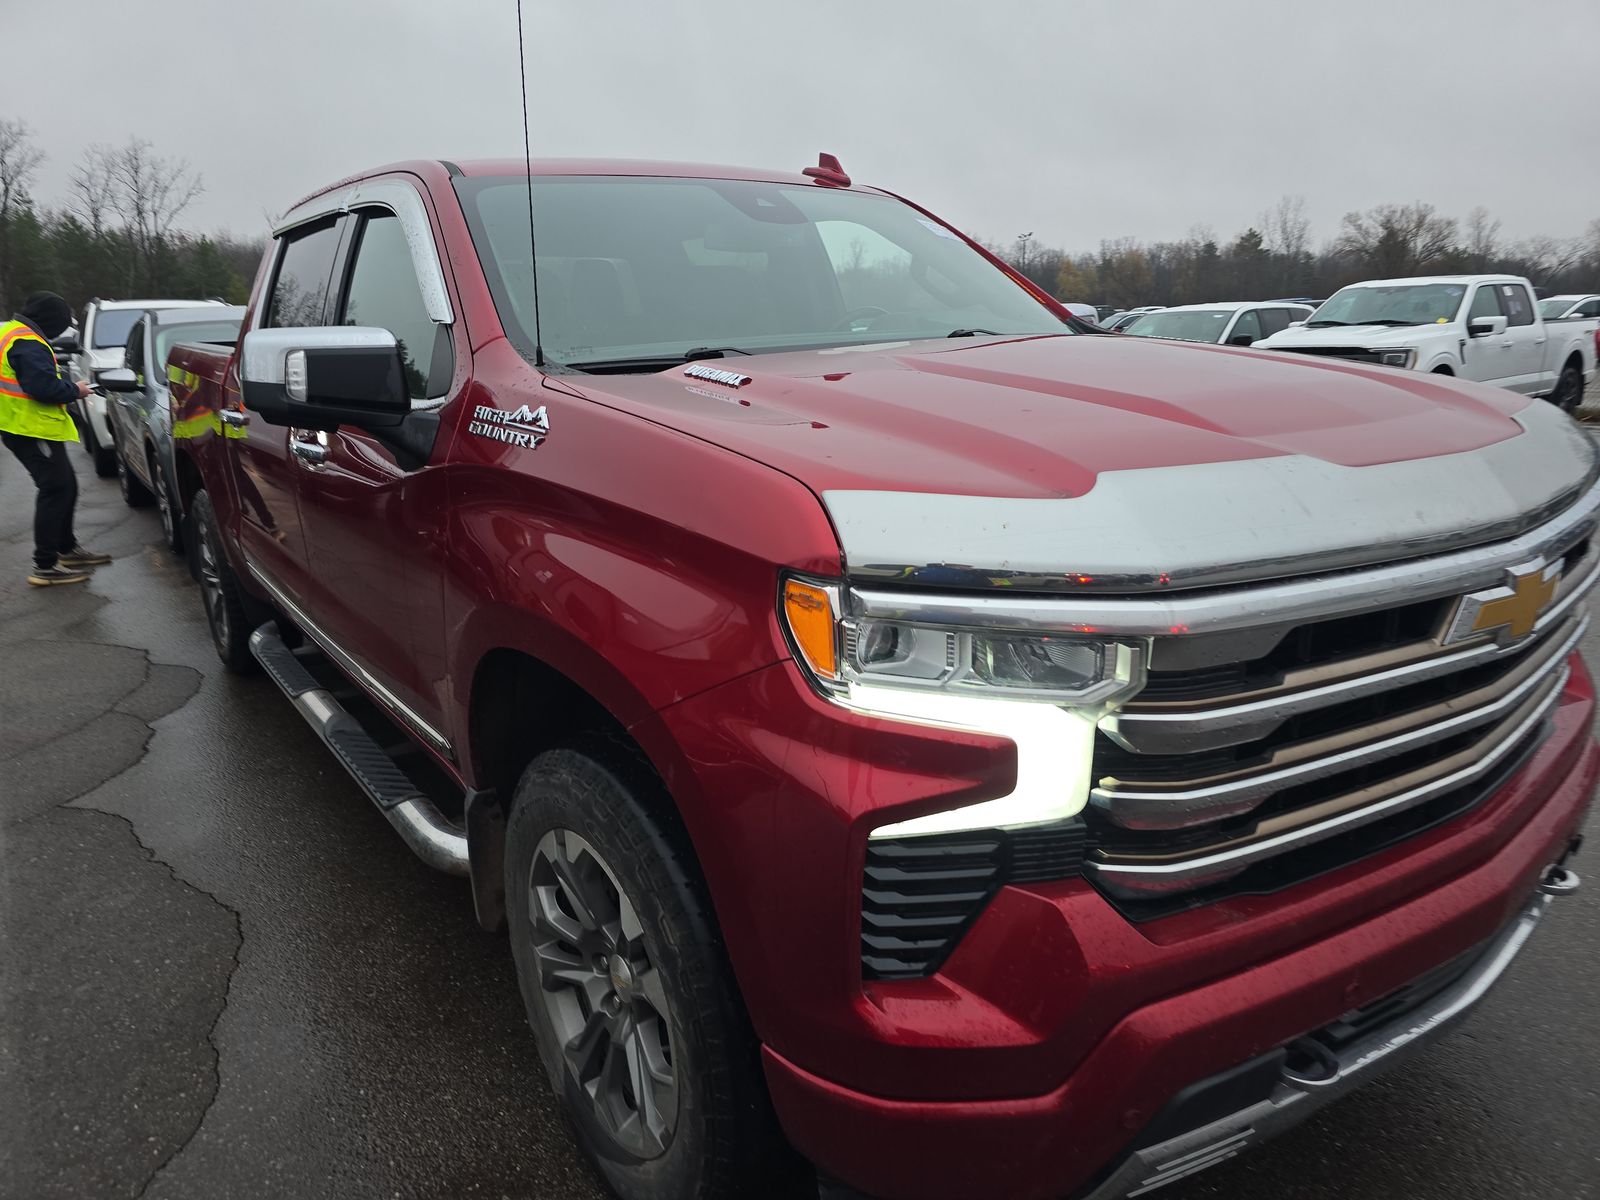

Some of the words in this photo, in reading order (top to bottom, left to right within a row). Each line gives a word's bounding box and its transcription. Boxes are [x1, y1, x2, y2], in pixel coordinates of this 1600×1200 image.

[684, 364, 752, 388] DURAMAX
[474, 405, 511, 425] HIGH
[468, 420, 545, 449] COUNTRY
